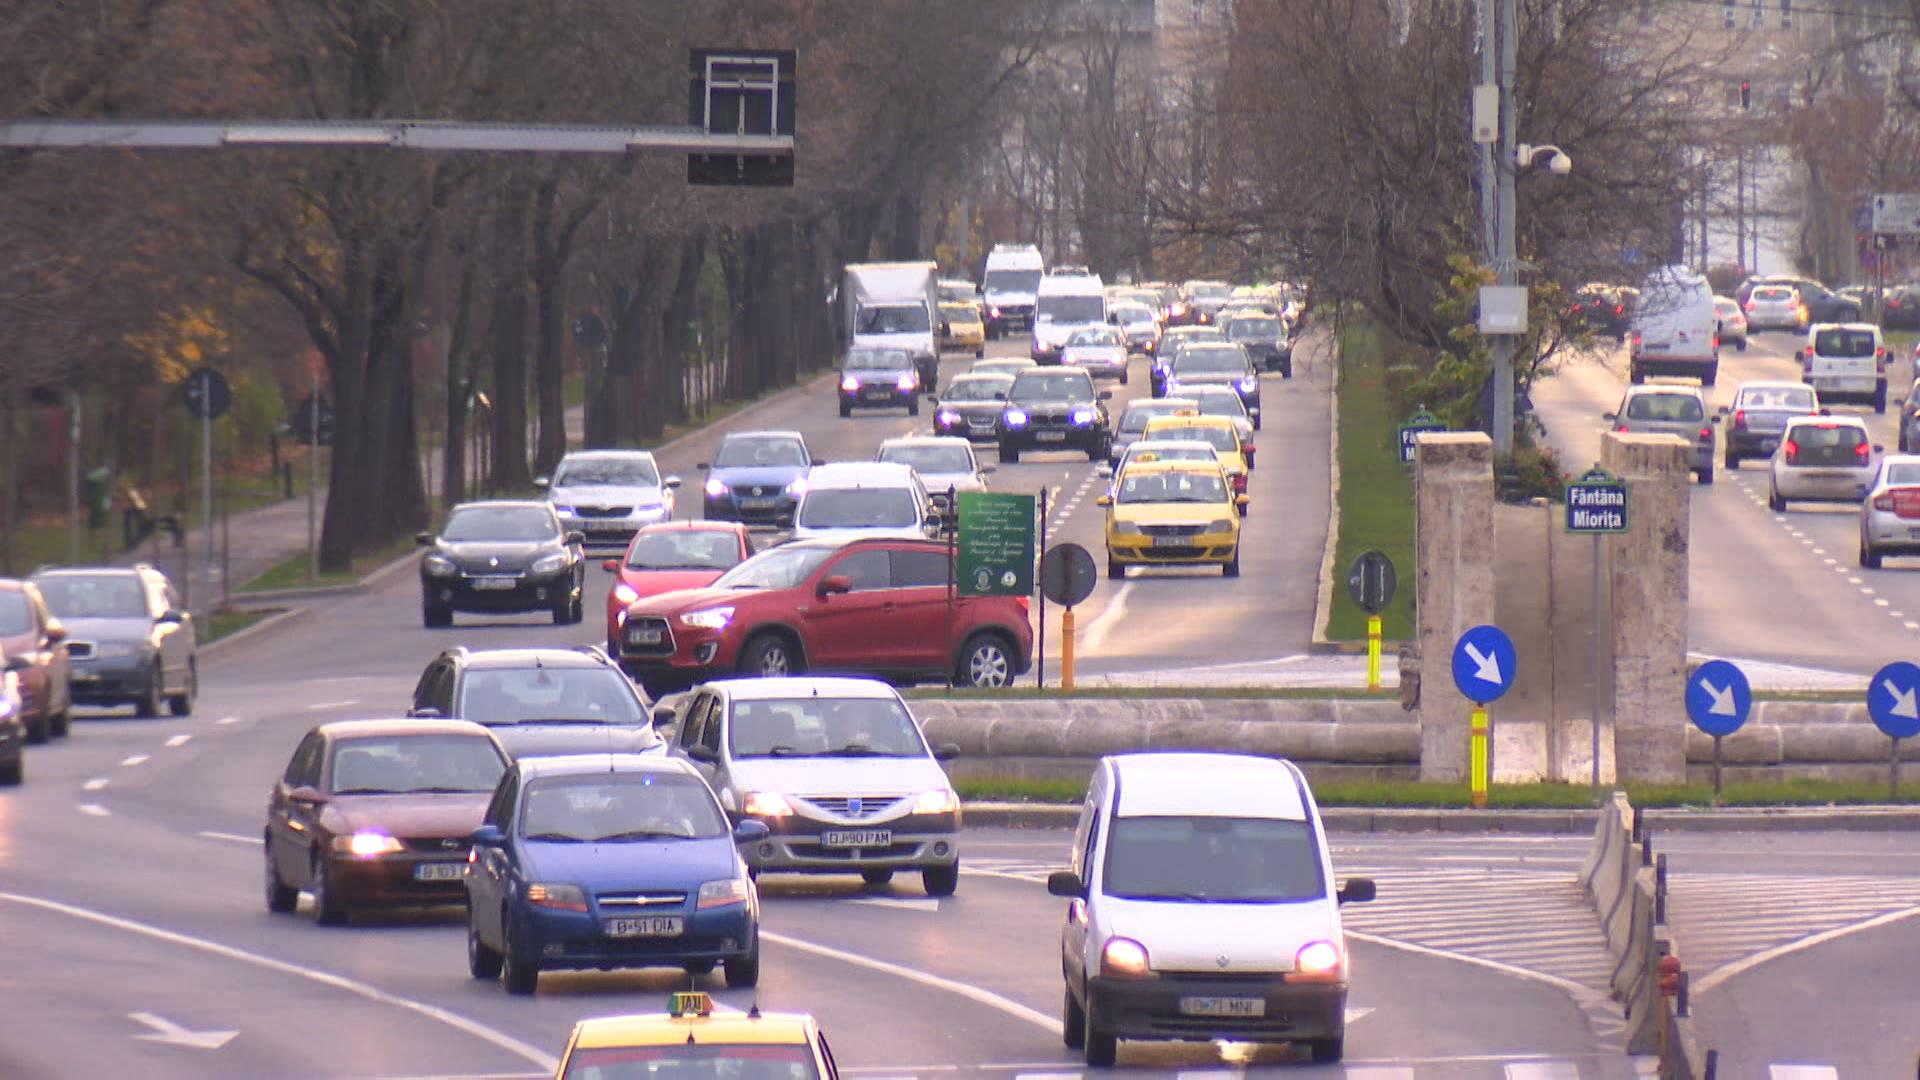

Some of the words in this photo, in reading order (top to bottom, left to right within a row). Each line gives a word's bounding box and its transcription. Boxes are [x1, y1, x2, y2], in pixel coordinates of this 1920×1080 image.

[1571, 488, 1624, 505] Fântâna
[1574, 510, 1621, 529] Miorița
[681, 994, 702, 1011] TAXI
